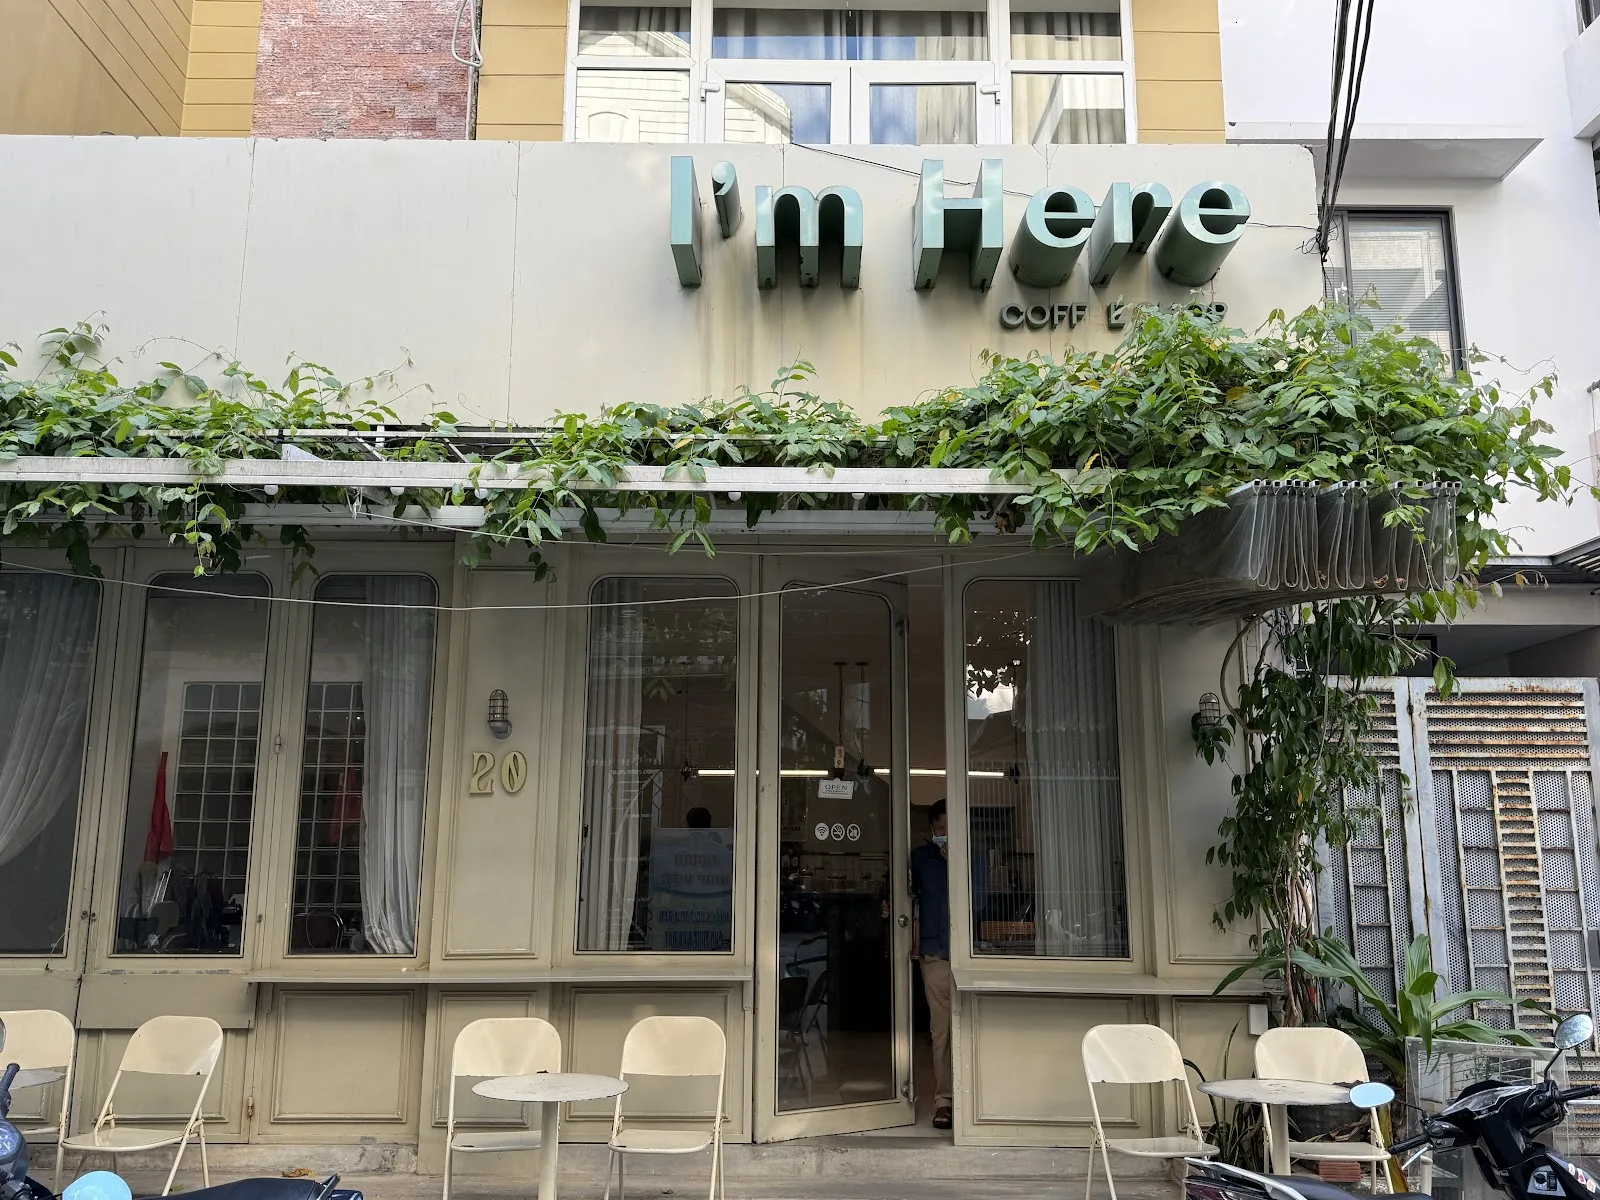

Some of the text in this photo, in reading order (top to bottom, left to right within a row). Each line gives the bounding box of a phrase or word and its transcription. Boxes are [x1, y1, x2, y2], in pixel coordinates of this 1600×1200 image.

[670, 156, 1251, 290] I'm Here
[469, 751, 527, 795] 20
